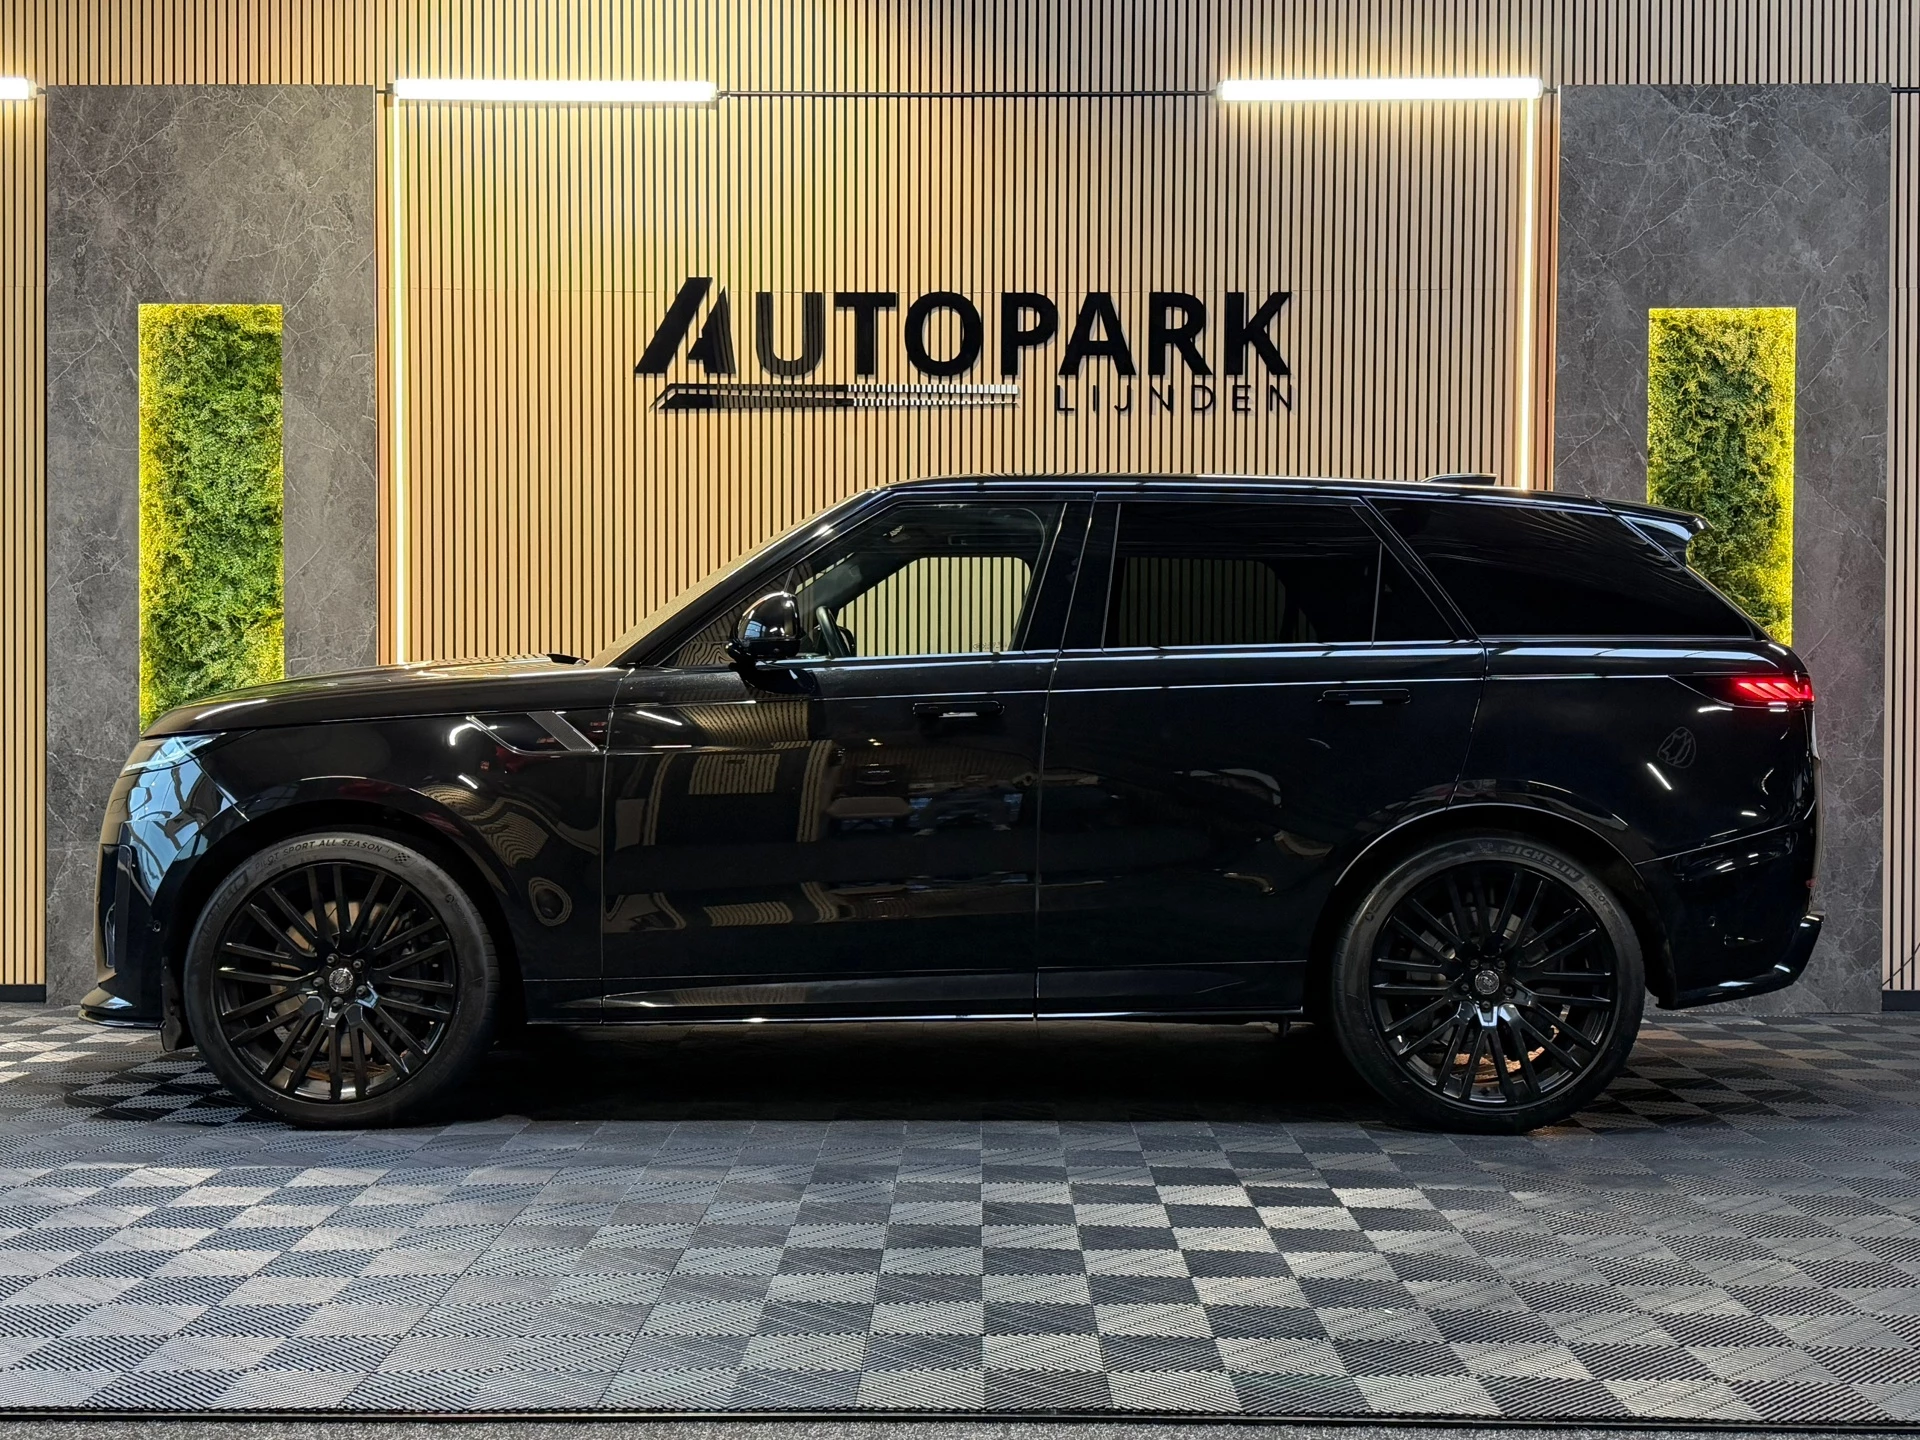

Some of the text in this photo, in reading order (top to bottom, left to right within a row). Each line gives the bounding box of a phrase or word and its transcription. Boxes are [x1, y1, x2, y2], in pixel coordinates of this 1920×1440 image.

[633, 277, 1292, 376] AUTOPARK
[1056, 384, 1293, 414] LIJNDEN
[254, 852, 279, 871] PILOT
[283, 841, 315, 856] SPORT
[318, 839, 337, 848] ALL
[340, 839, 383, 853] SEASON
[1501, 845, 1580, 879] MICHELIN
[1587, 883, 1611, 908] PILOT
